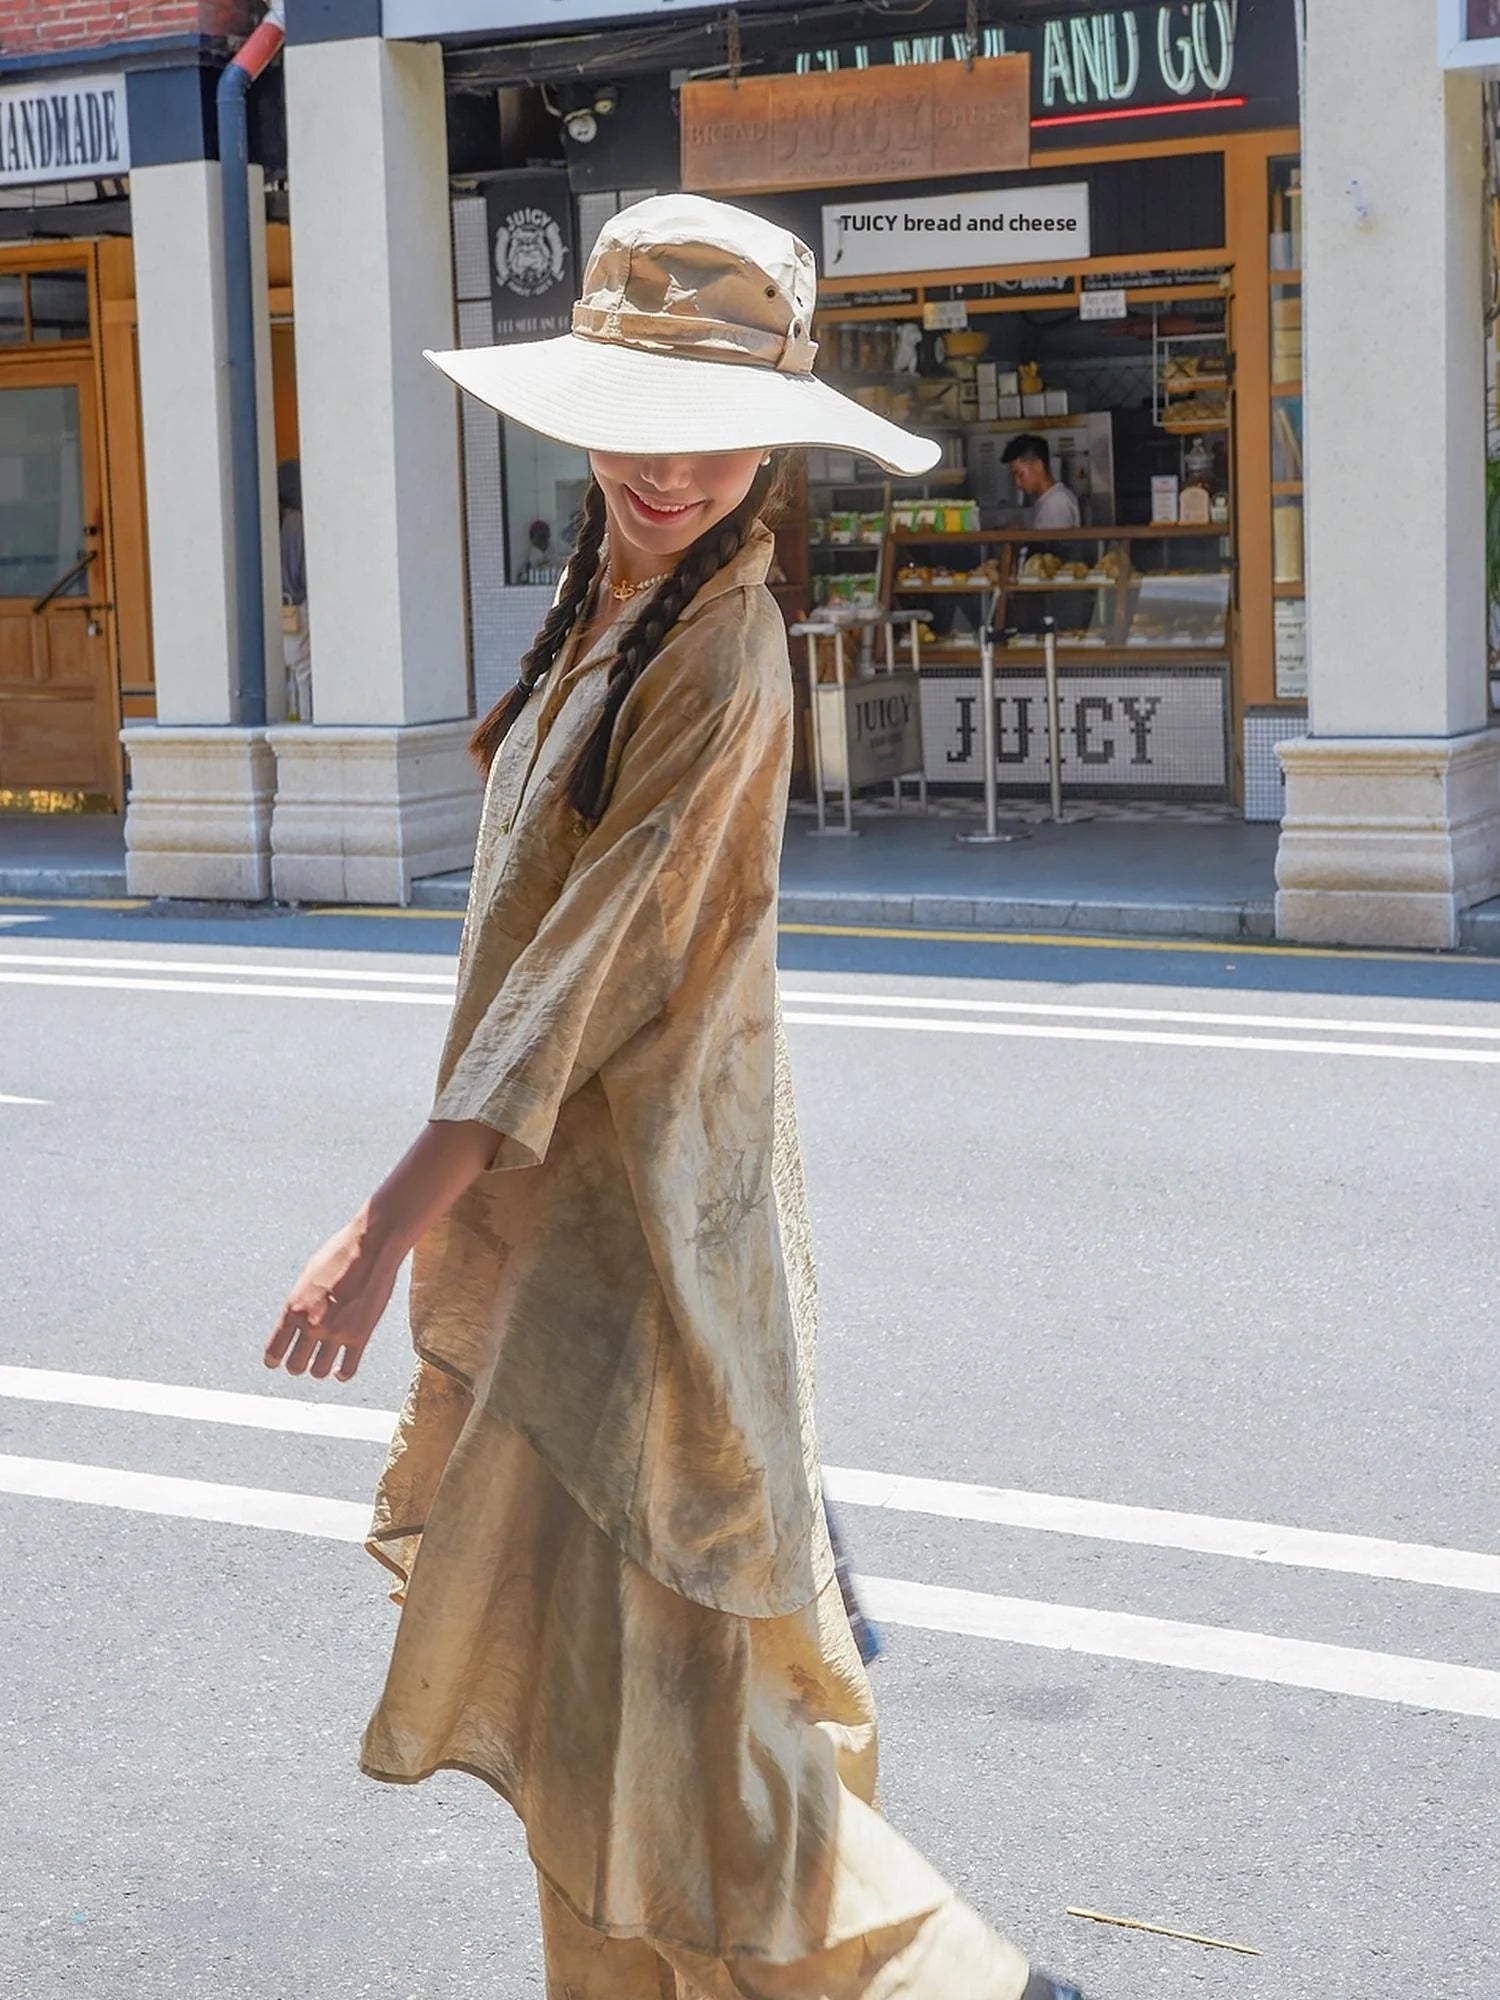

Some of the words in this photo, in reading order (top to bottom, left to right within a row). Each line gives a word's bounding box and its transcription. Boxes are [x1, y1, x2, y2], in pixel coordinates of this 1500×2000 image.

[1042, 10, 1138, 106] AND
[1157, 0, 1237, 95] GO
[776, 91, 927, 160] JUICY
[506, 207, 552, 231] JUICY
[904, 214, 961, 231] bread
[967, 214, 1003, 231] and
[1009, 214, 1077, 231] cheese
[856, 692, 912, 741] JUICY
[947, 697, 1161, 764] JUCY
